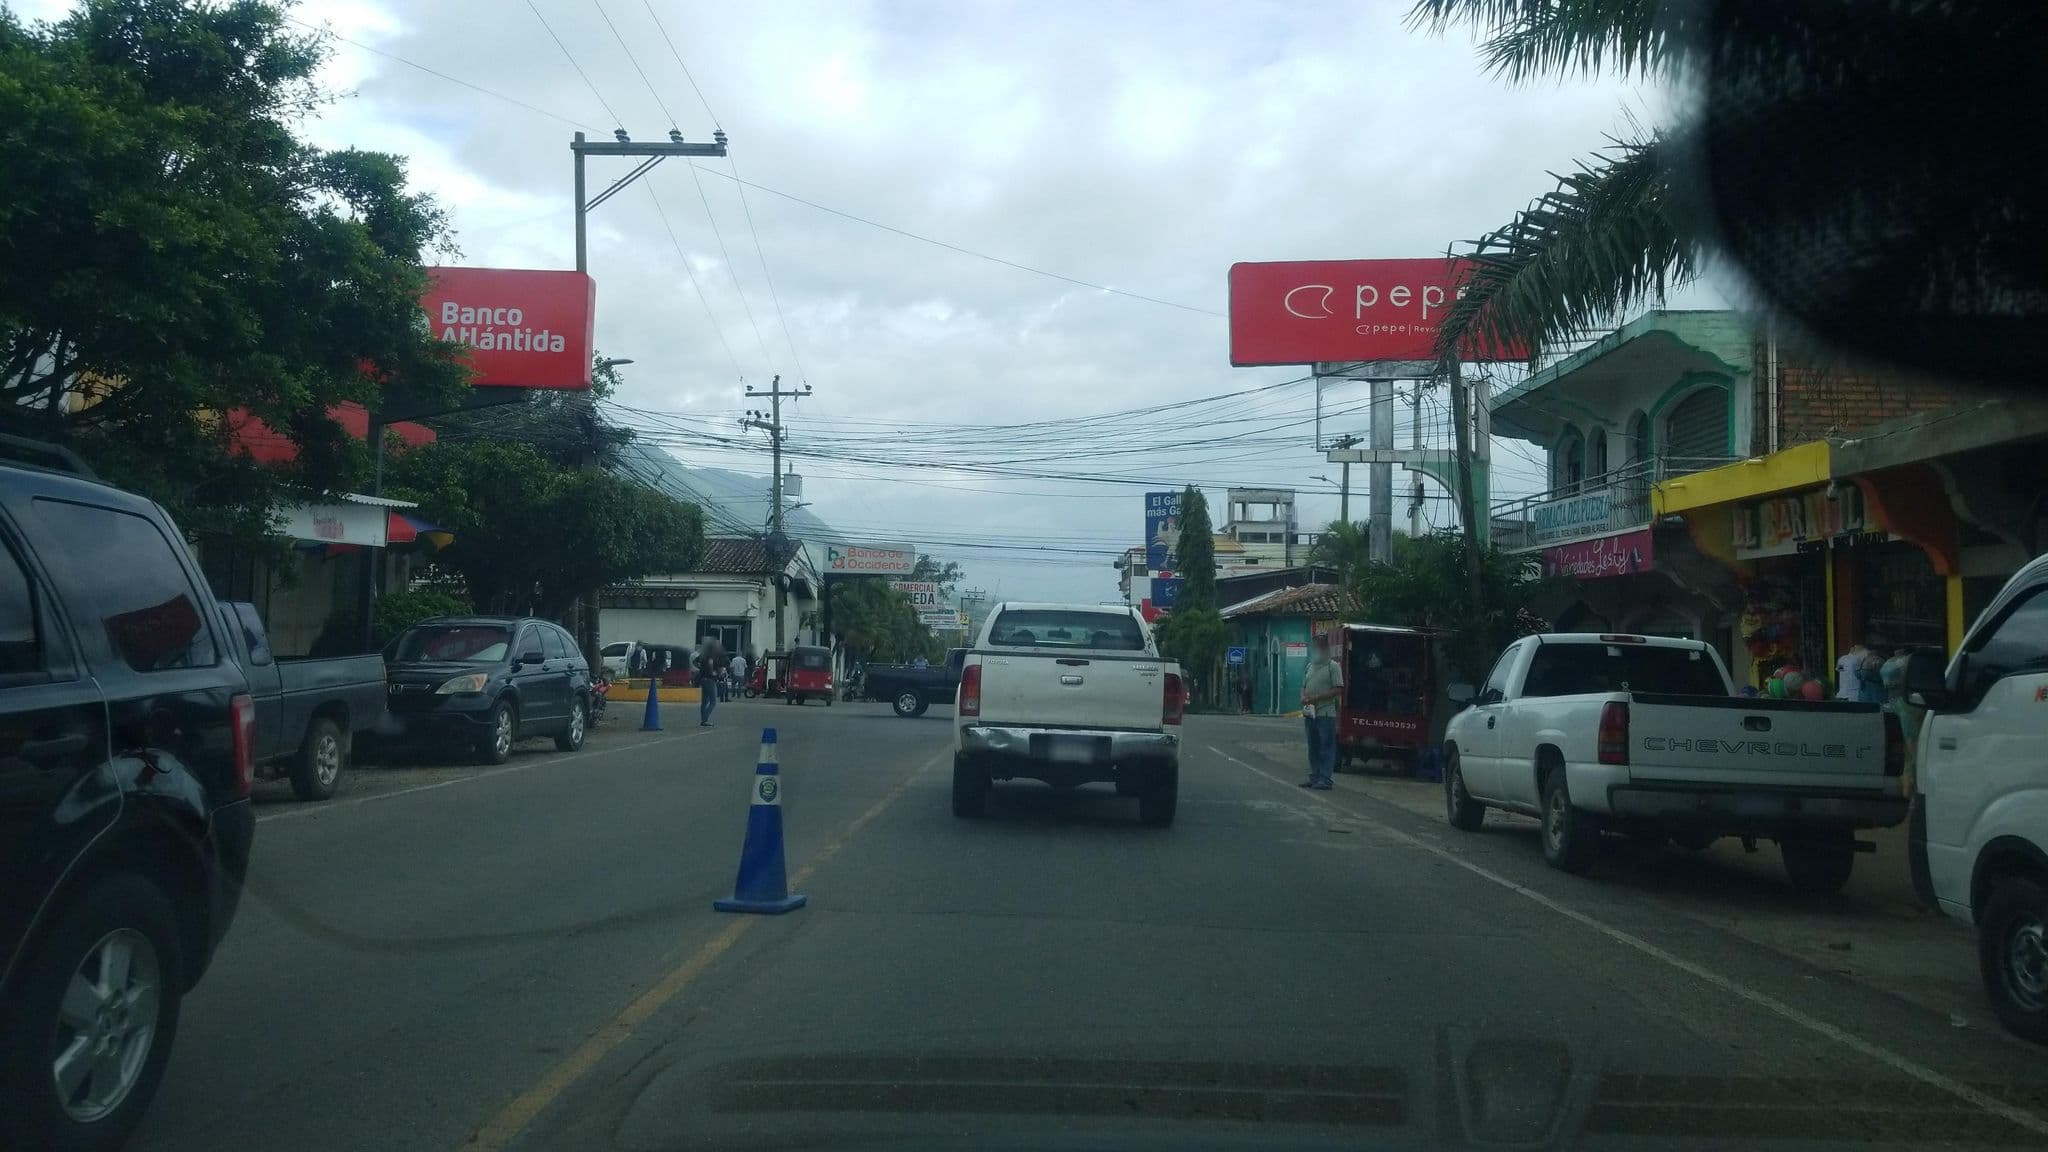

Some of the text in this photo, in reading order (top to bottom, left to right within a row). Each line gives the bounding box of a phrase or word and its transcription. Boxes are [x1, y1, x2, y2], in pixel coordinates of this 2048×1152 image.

[441, 302, 523, 326] Banco
[1372, 324, 1406, 335] pepe
[441, 326, 566, 353] Atlántida
[1152, 495, 1182, 506] El Gall
[847, 546, 887, 558] Banco
[888, 547, 904, 558] de
[847, 560, 910, 571] Occidente
[894, 583, 935, 593] COMERCIAL
